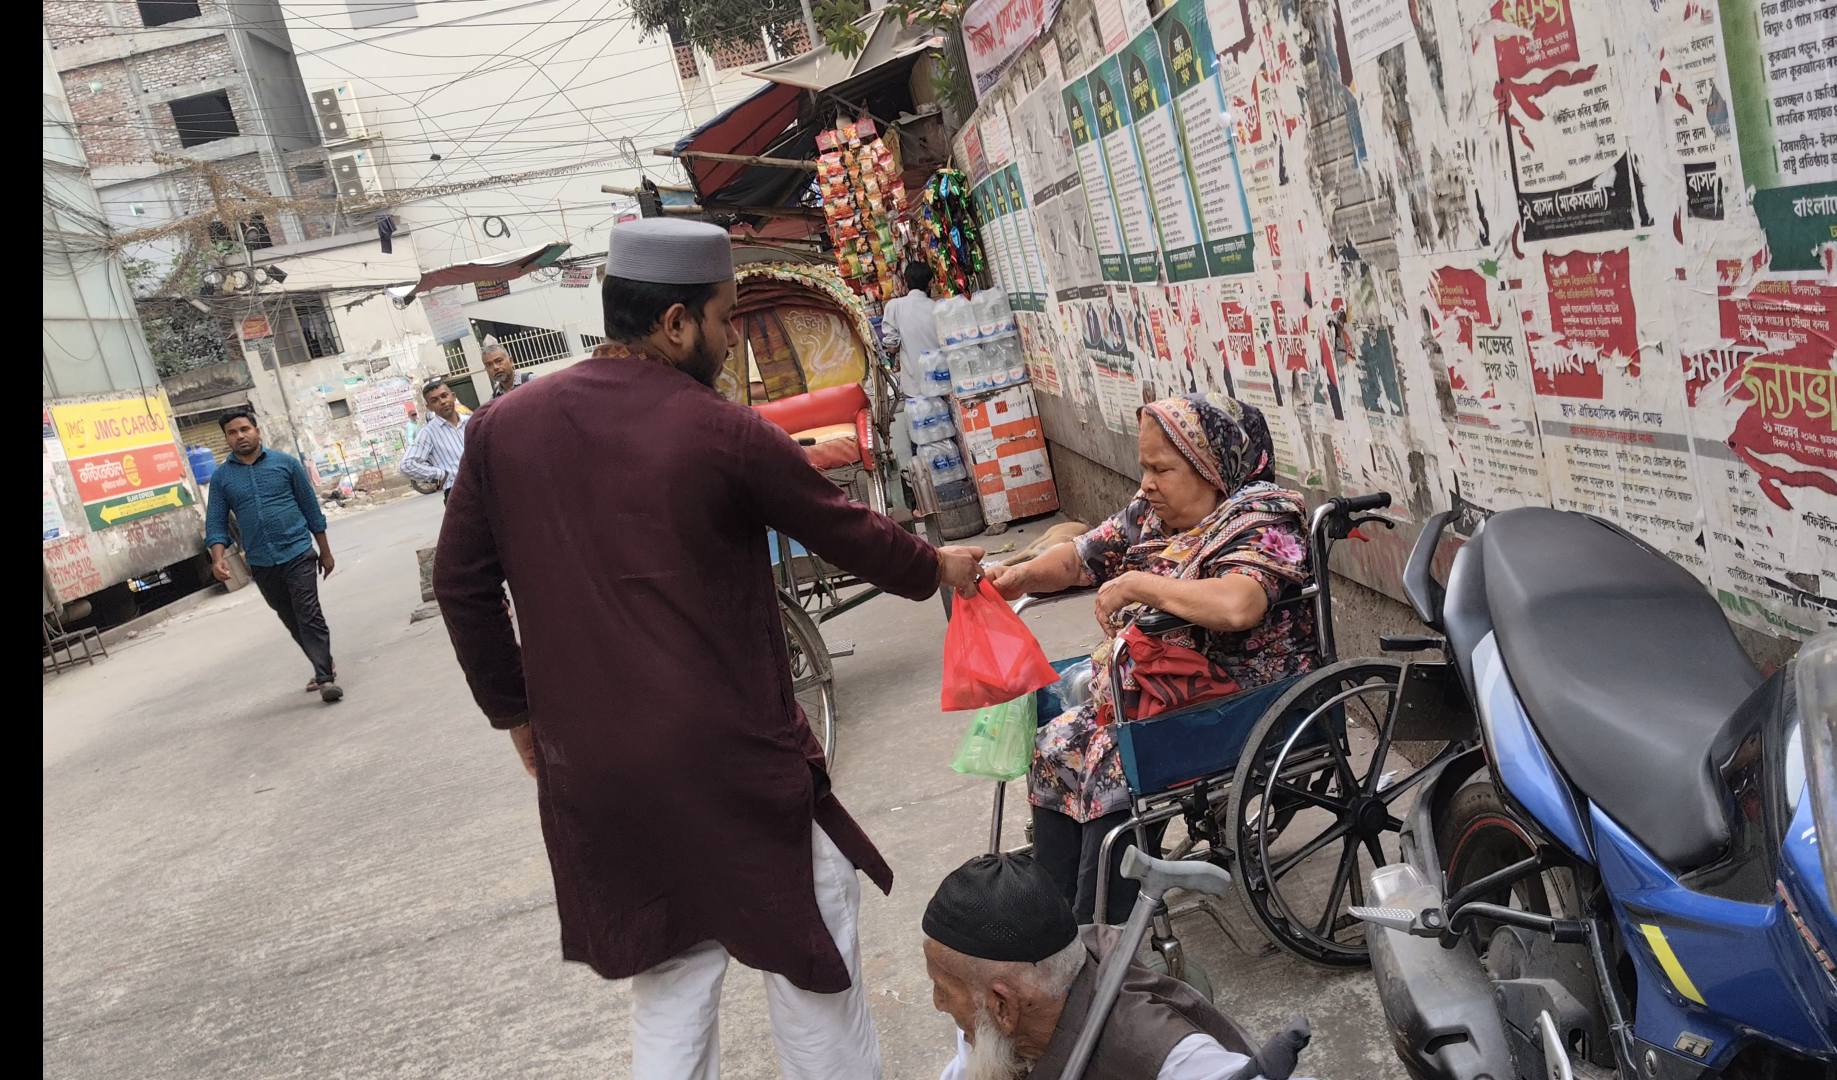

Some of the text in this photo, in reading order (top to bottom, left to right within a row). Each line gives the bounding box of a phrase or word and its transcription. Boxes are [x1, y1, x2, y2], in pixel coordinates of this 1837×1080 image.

[1786, 18, 1793, 30] ও
[1532, 197, 1555, 217] বাসদ
[1477, 336, 1514, 356] নভেম্বর
[1482, 361, 1502, 380] দুপুর
[1578, 403, 1617, 420] ঐতিহাসিক
[1643, 412, 1664, 428] মোড়
[95, 413, 165, 440] JMG CARGO
[1774, 423, 1799, 439] নভেম্বর
